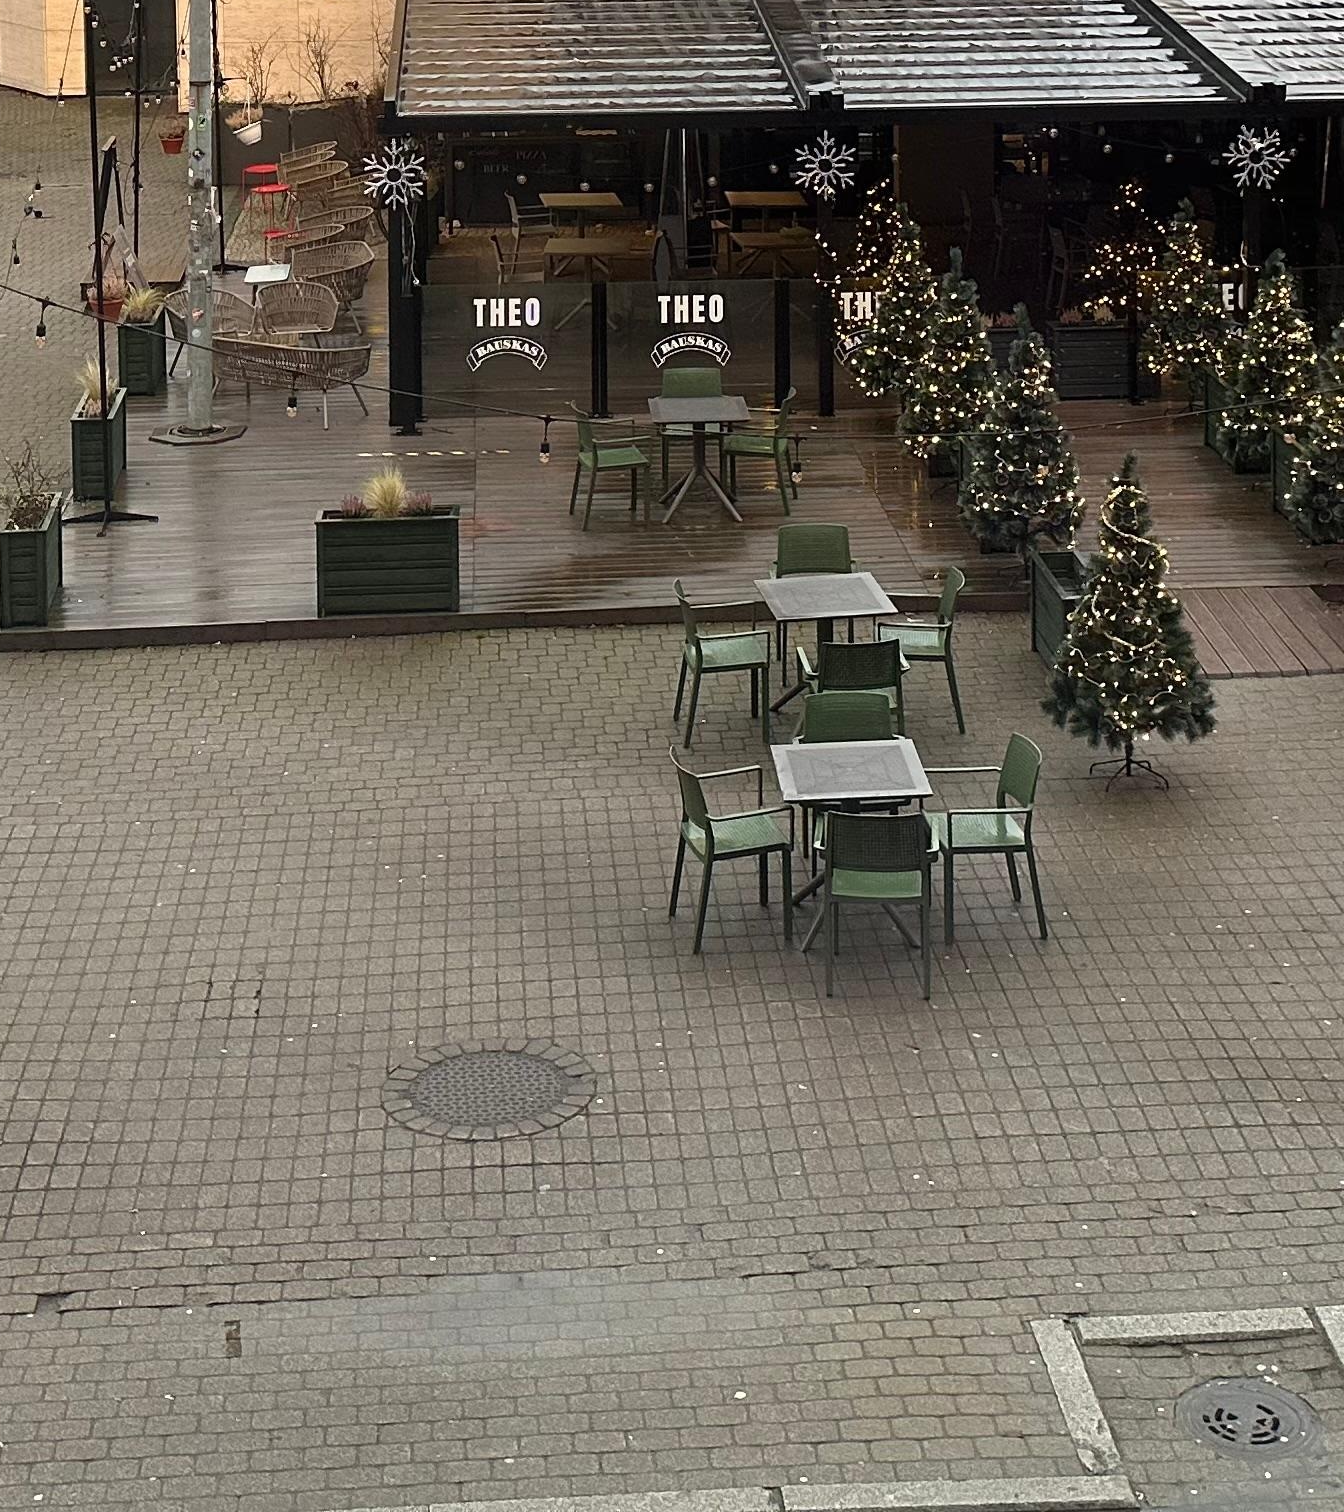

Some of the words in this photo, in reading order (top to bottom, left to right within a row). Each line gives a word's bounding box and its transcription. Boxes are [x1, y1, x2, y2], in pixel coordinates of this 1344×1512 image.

[473, 297, 540, 327] THEO
[657, 294, 724, 324] THEO
[476, 339, 540, 357] BAUSKAS
[660, 335, 723, 354] BAUSKAS
